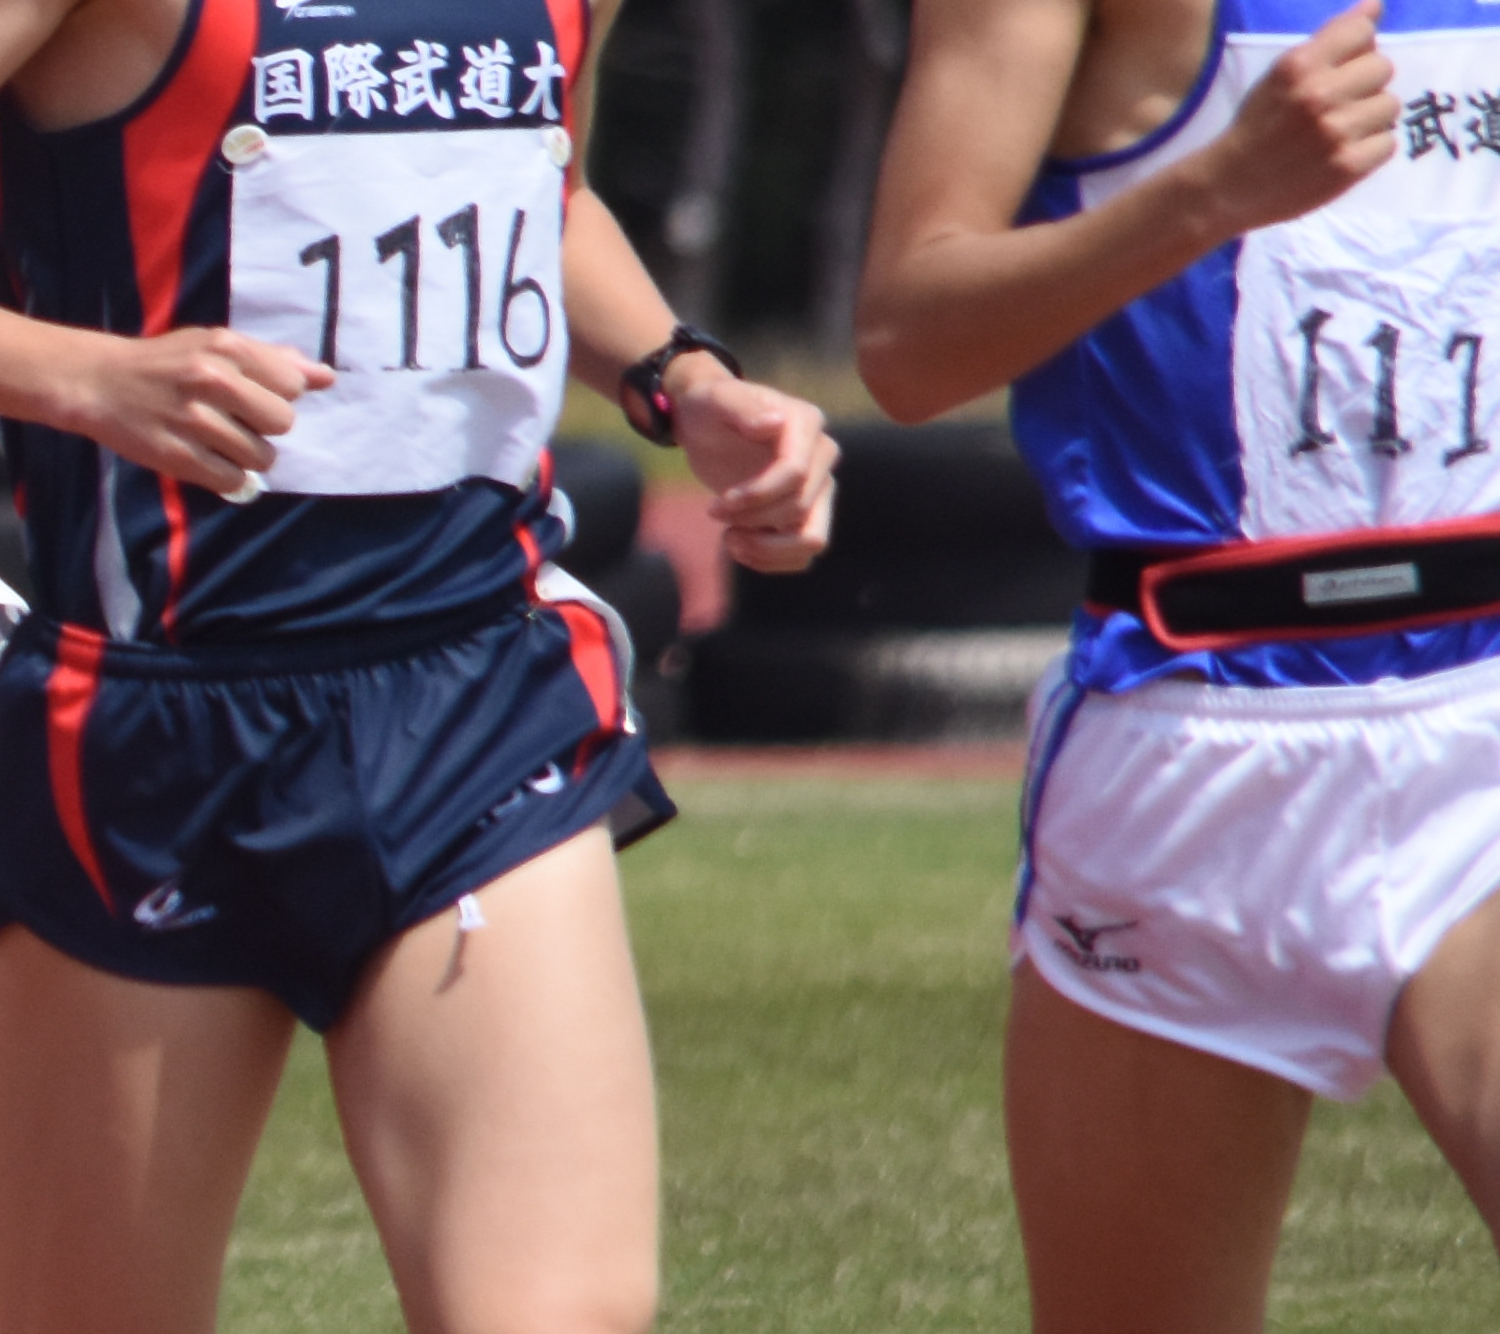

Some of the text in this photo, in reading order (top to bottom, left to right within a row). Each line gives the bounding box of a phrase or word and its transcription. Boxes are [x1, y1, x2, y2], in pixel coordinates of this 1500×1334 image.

[252, 39, 565, 124] 国際武道大
[299, 202, 551, 372] 1116
